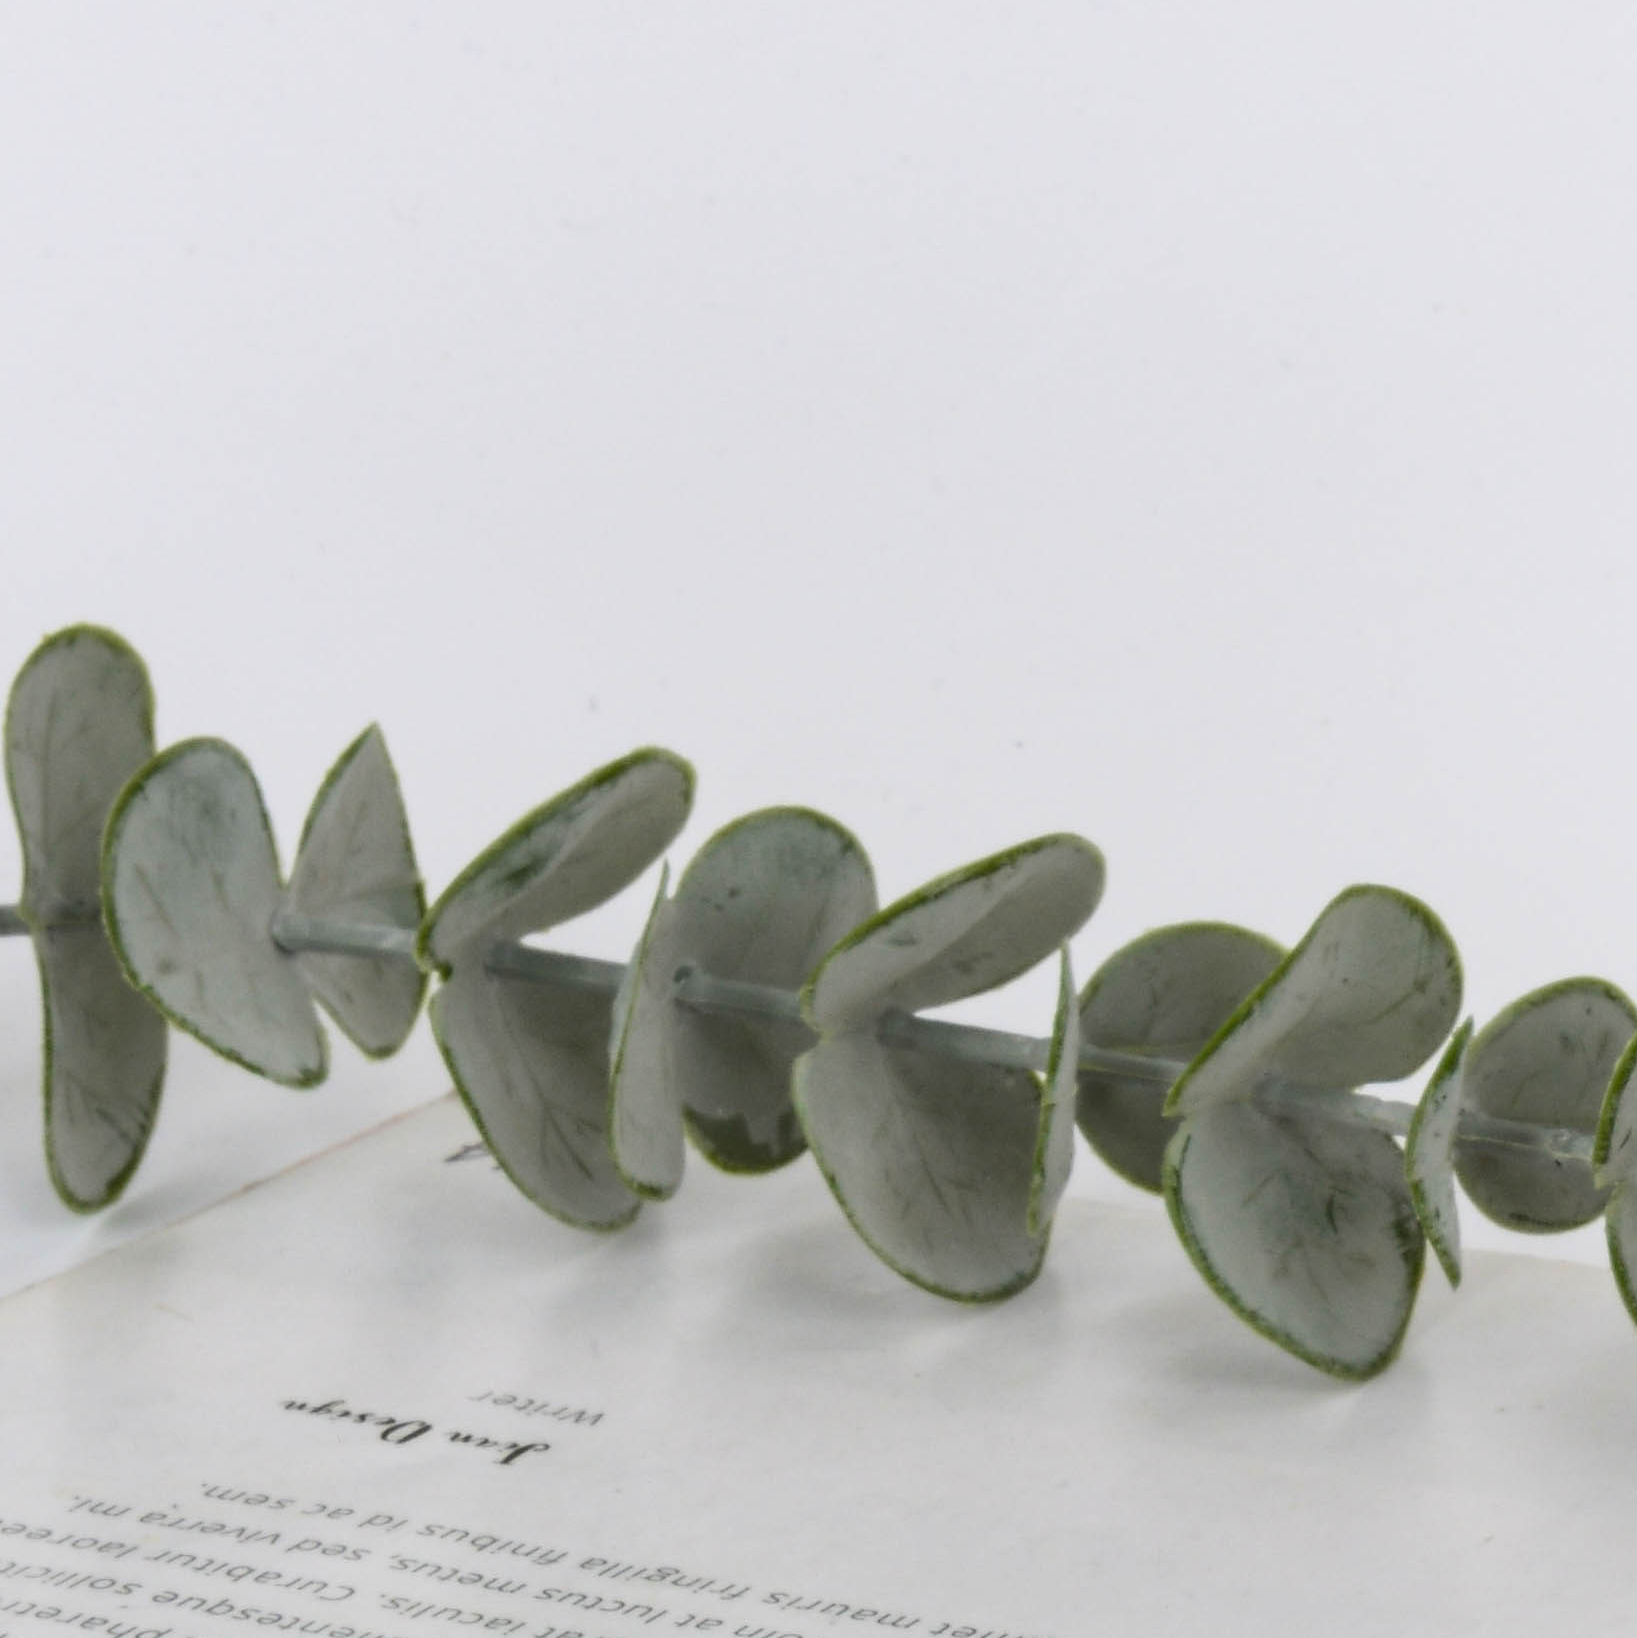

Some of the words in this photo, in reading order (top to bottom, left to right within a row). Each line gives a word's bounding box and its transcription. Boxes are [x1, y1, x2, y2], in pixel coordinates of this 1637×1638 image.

[279, 1398, 434, 1445] Design
[466, 1389, 604, 1426] Writer
[137, 1510, 283, 1546] viverra
[300, 1502, 356, 1521] ac
[356, 1513, 410, 1533] id
[0, 1518, 140, 1560] laoree
[284, 1537, 373, 1562] sed
[415, 1523, 570, 1567] finibus
[143, 1549, 357, 1602] Curabitur
[577, 1556, 753, 1602] fringilla
[531, 1587, 670, 1626] luctus
[672, 1612, 725, 1632] at
[760, 1591, 922, 1630] mauris
